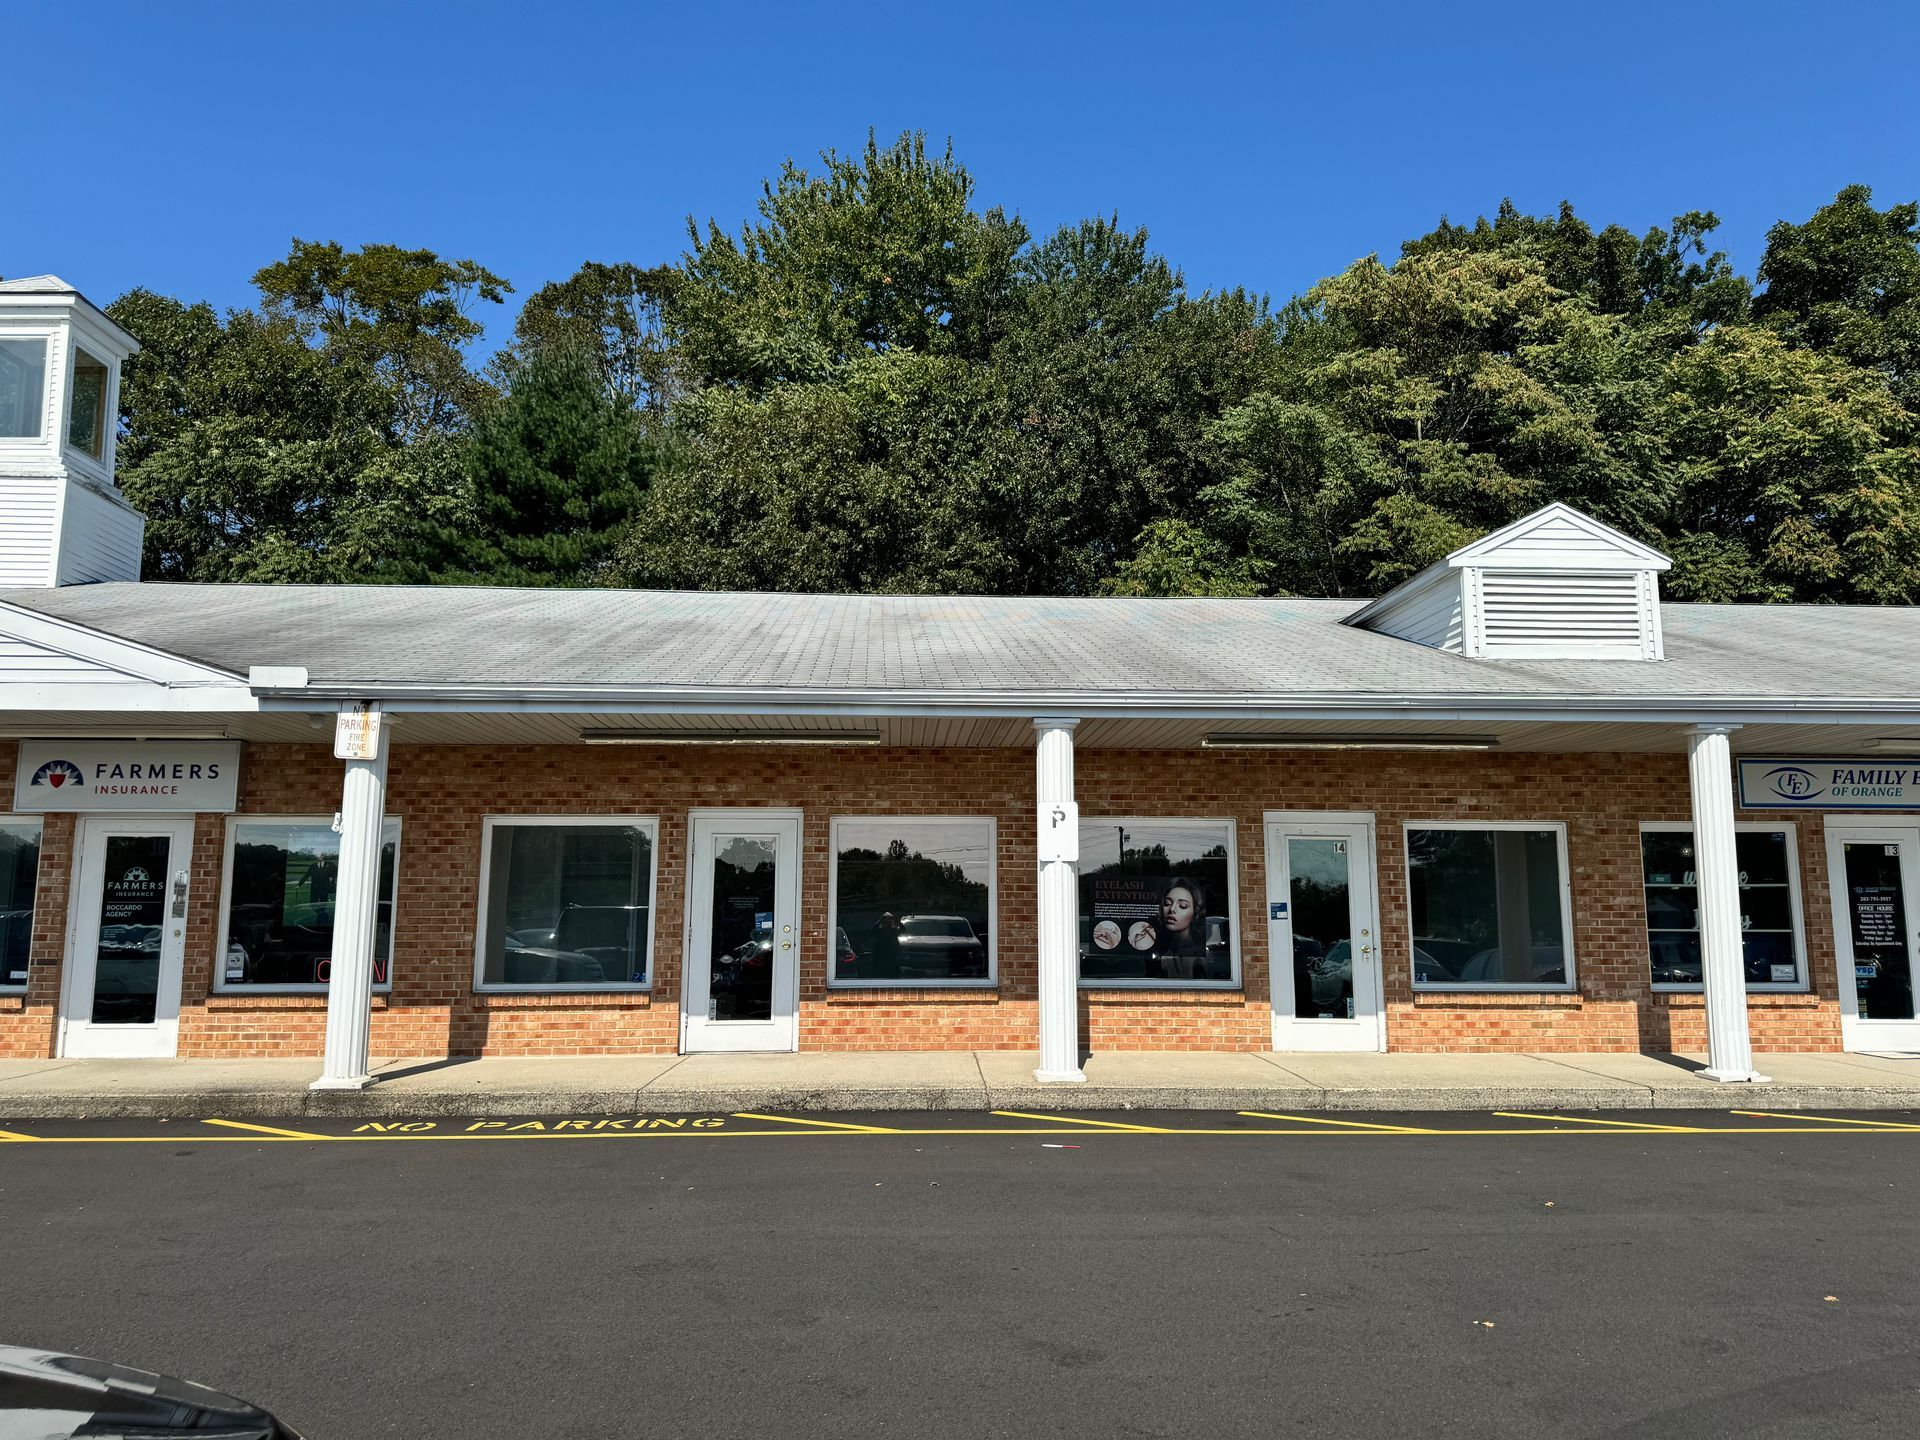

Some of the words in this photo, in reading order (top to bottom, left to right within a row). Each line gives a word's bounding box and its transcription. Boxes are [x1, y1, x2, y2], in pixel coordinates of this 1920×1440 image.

[353, 705, 367, 716] NO
[340, 719, 377, 731] PARKING
[350, 733, 365, 742] FIRE
[346, 743, 366, 752] ZONE
[95, 763, 220, 779] FARMERS
[1831, 769, 1907, 785] FAMILY
[94, 785, 178, 795] INSURANCE
[1831, 786, 1849, 797] OF
[1851, 787, 1902, 797] ORANGE
[1333, 843, 1345, 853] 14
[107, 881, 164, 890] FARMERS
[1095, 880, 1144, 890] EYELASH
[352, 1122, 437, 1132] NO
[465, 1118, 727, 1132] PARKING
